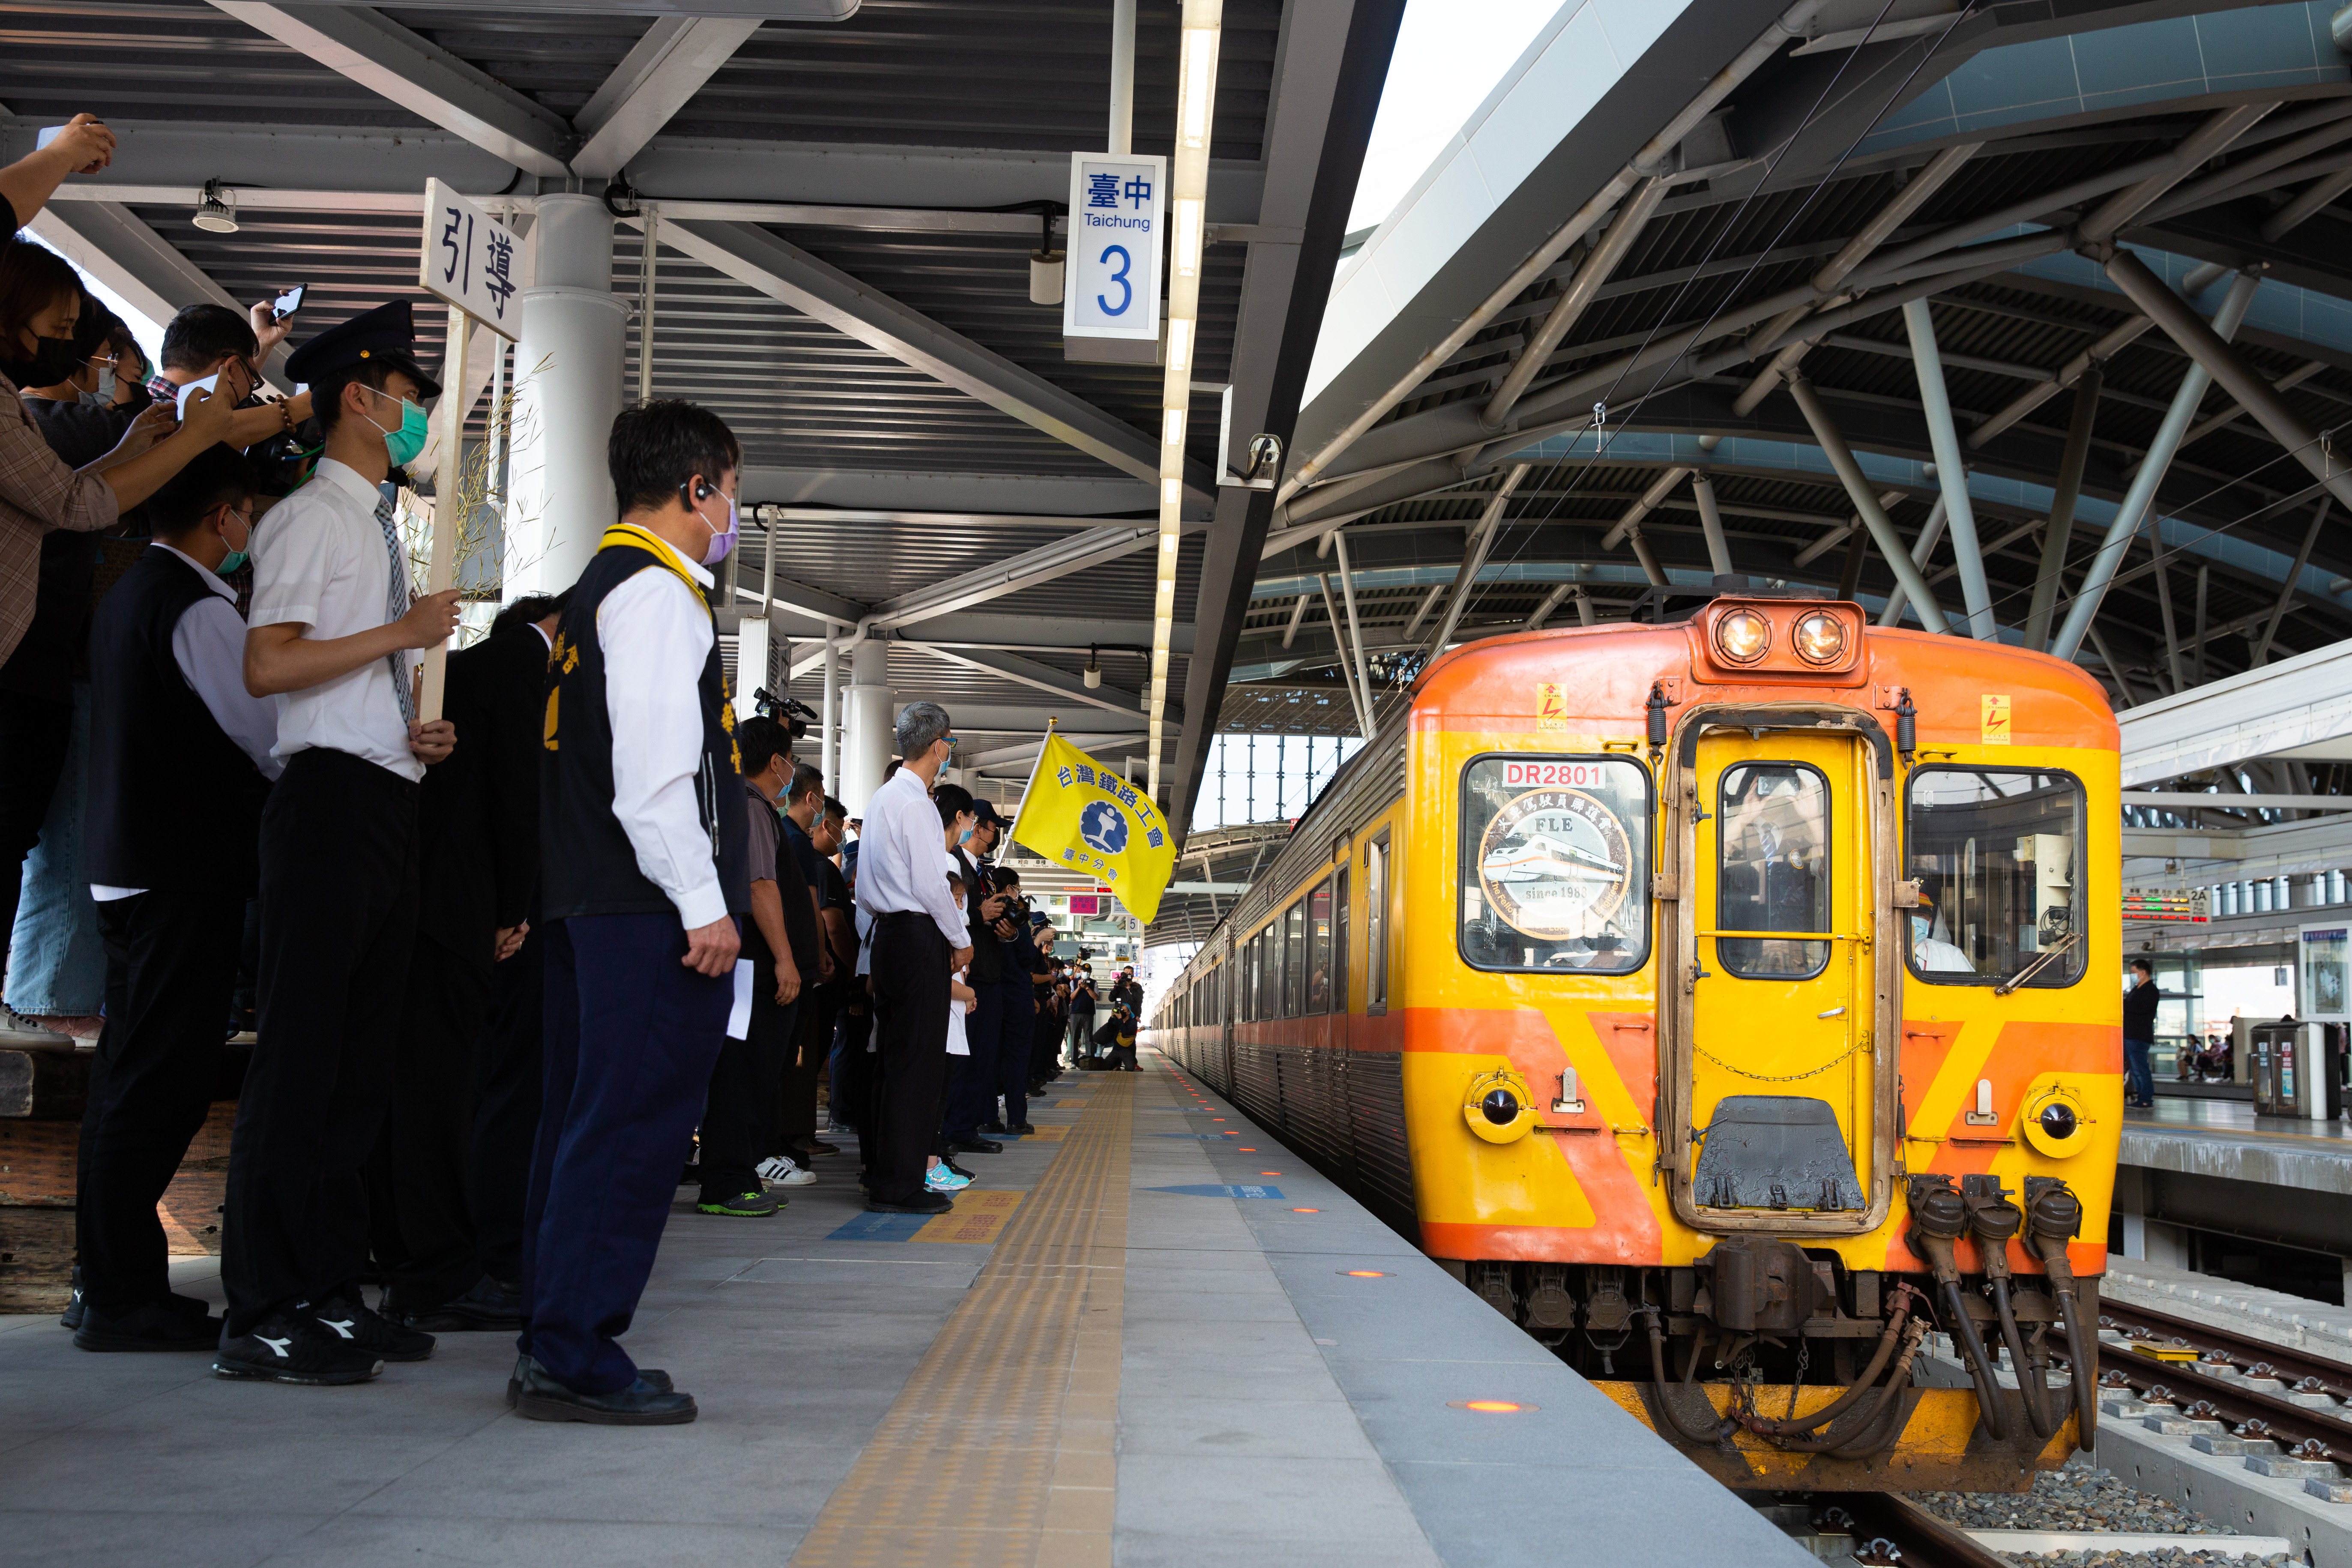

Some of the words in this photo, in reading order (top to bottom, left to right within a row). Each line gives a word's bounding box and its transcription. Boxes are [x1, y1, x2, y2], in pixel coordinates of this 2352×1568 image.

[1087, 173, 1151, 210] 臺中
[1084, 213, 1150, 232] Taichung
[442, 207, 517, 320] 引導
[1097, 245, 1132, 316] 3
[1507, 764, 1600, 785] DR2801
[1056, 763, 1164, 849] 台灣鐵路工會
[1535, 818, 1573, 832] FLE
[1062, 847, 1118, 882] 臺中分會
[1491, 878, 1500, 895] The
[1526, 887, 1558, 899] since
[1562, 886, 1587, 898] 1988
[2192, 891, 2206, 901] 2A
[1130, 919, 1135, 929] 5
